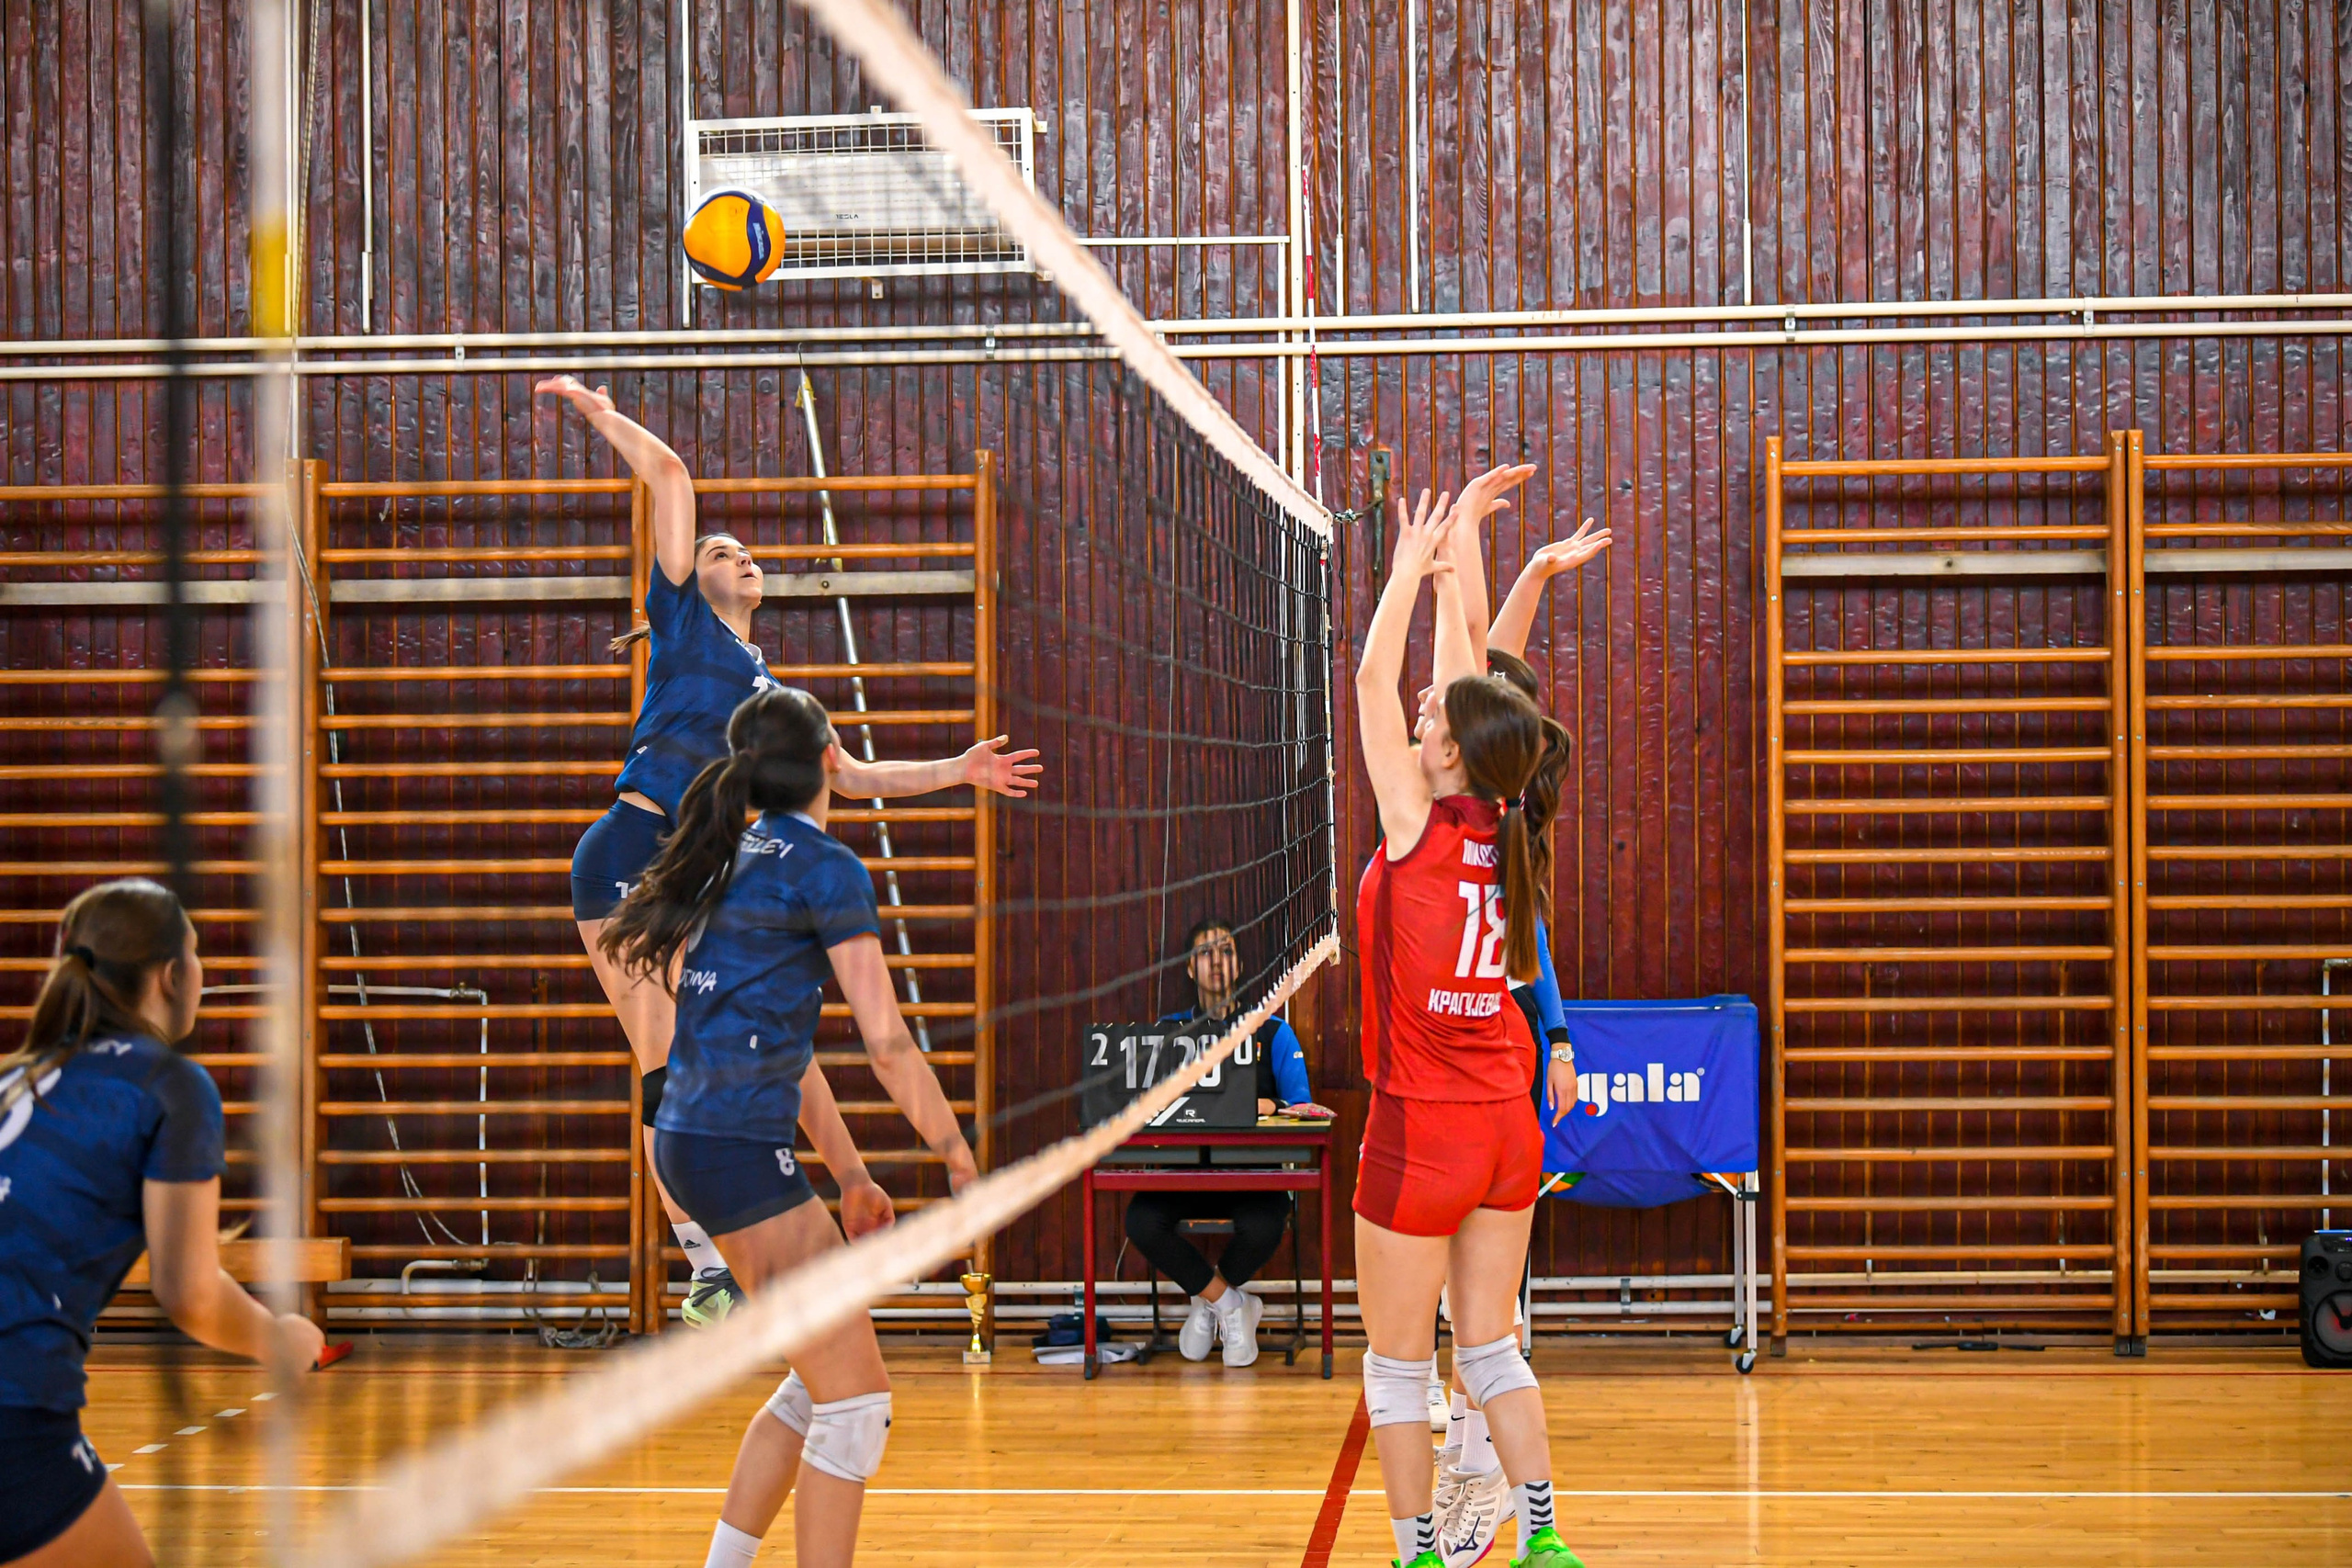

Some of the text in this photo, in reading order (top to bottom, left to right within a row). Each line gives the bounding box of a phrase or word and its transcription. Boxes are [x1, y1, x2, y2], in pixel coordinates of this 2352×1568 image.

[1454, 880, 1507, 978] 18
[1091, 1032, 1108, 1066] 2
[1119, 1034, 1165, 1089] 17
[1577, 1063, 1701, 1117] gala
[775, 1147, 796, 1177] 8
